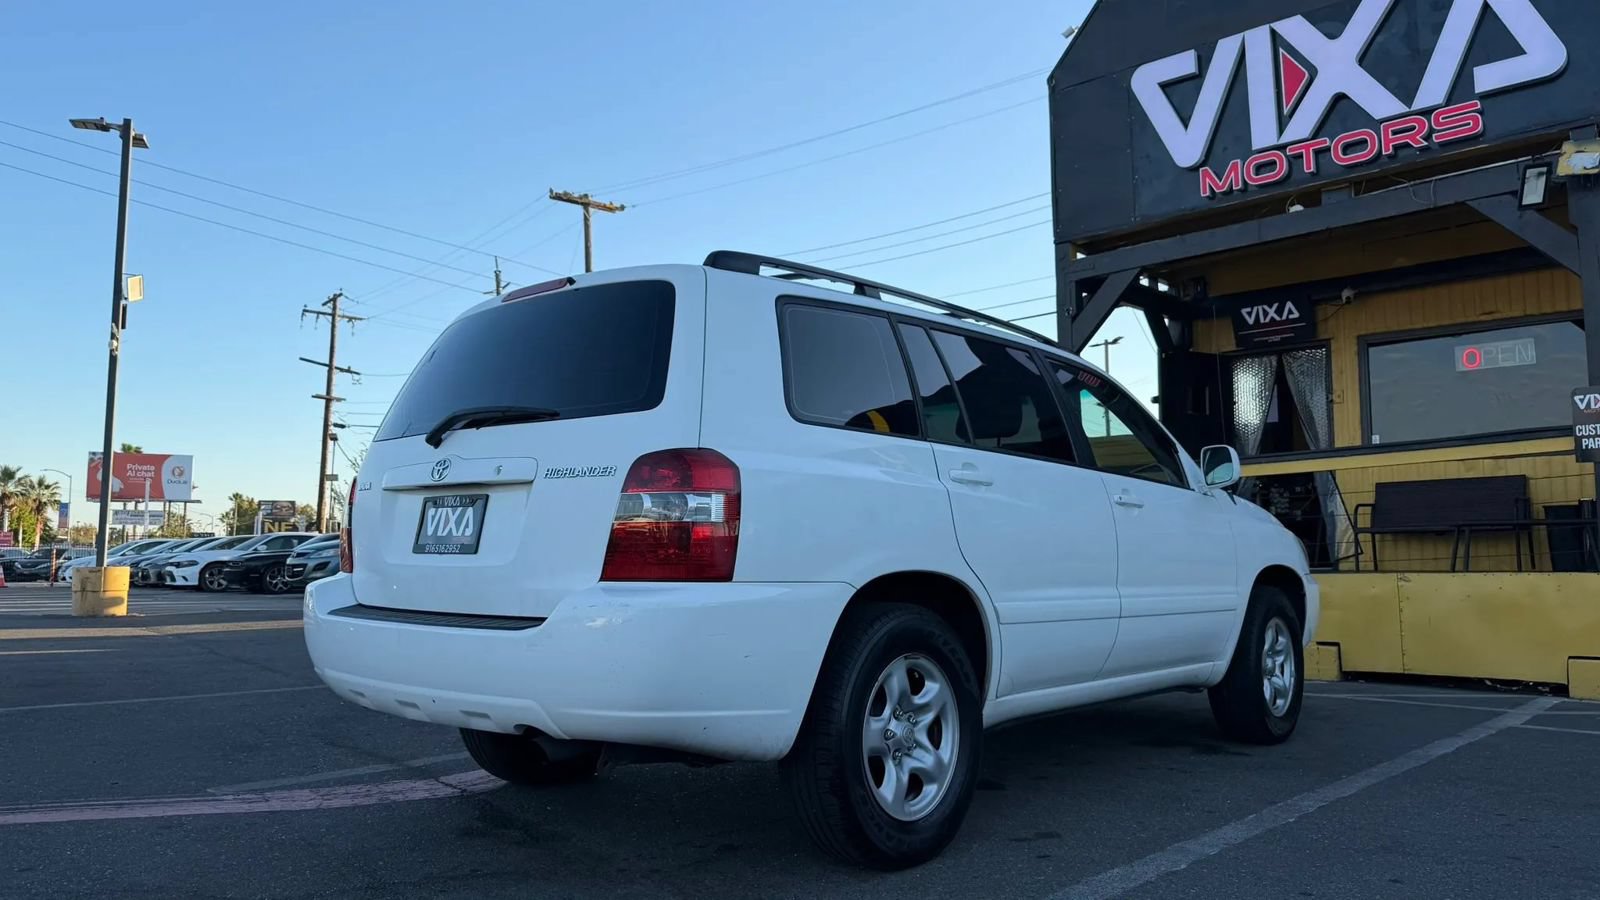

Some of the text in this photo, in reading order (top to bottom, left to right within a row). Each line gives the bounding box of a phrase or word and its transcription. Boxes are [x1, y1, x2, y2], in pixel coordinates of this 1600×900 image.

[1130, 0, 1568, 168] VIXA
[1200, 100, 1483, 197] MOTORS
[1240, 301, 1300, 325] VIXA
[1461, 343, 1533, 370] OPEN
[126, 463, 156, 471] Private
[543, 465, 617, 479] HIGHLANDER
[444, 496, 460, 507] VIXA
[427, 507, 474, 537] VIXA
[425, 544, 461, 553] 9165162952
